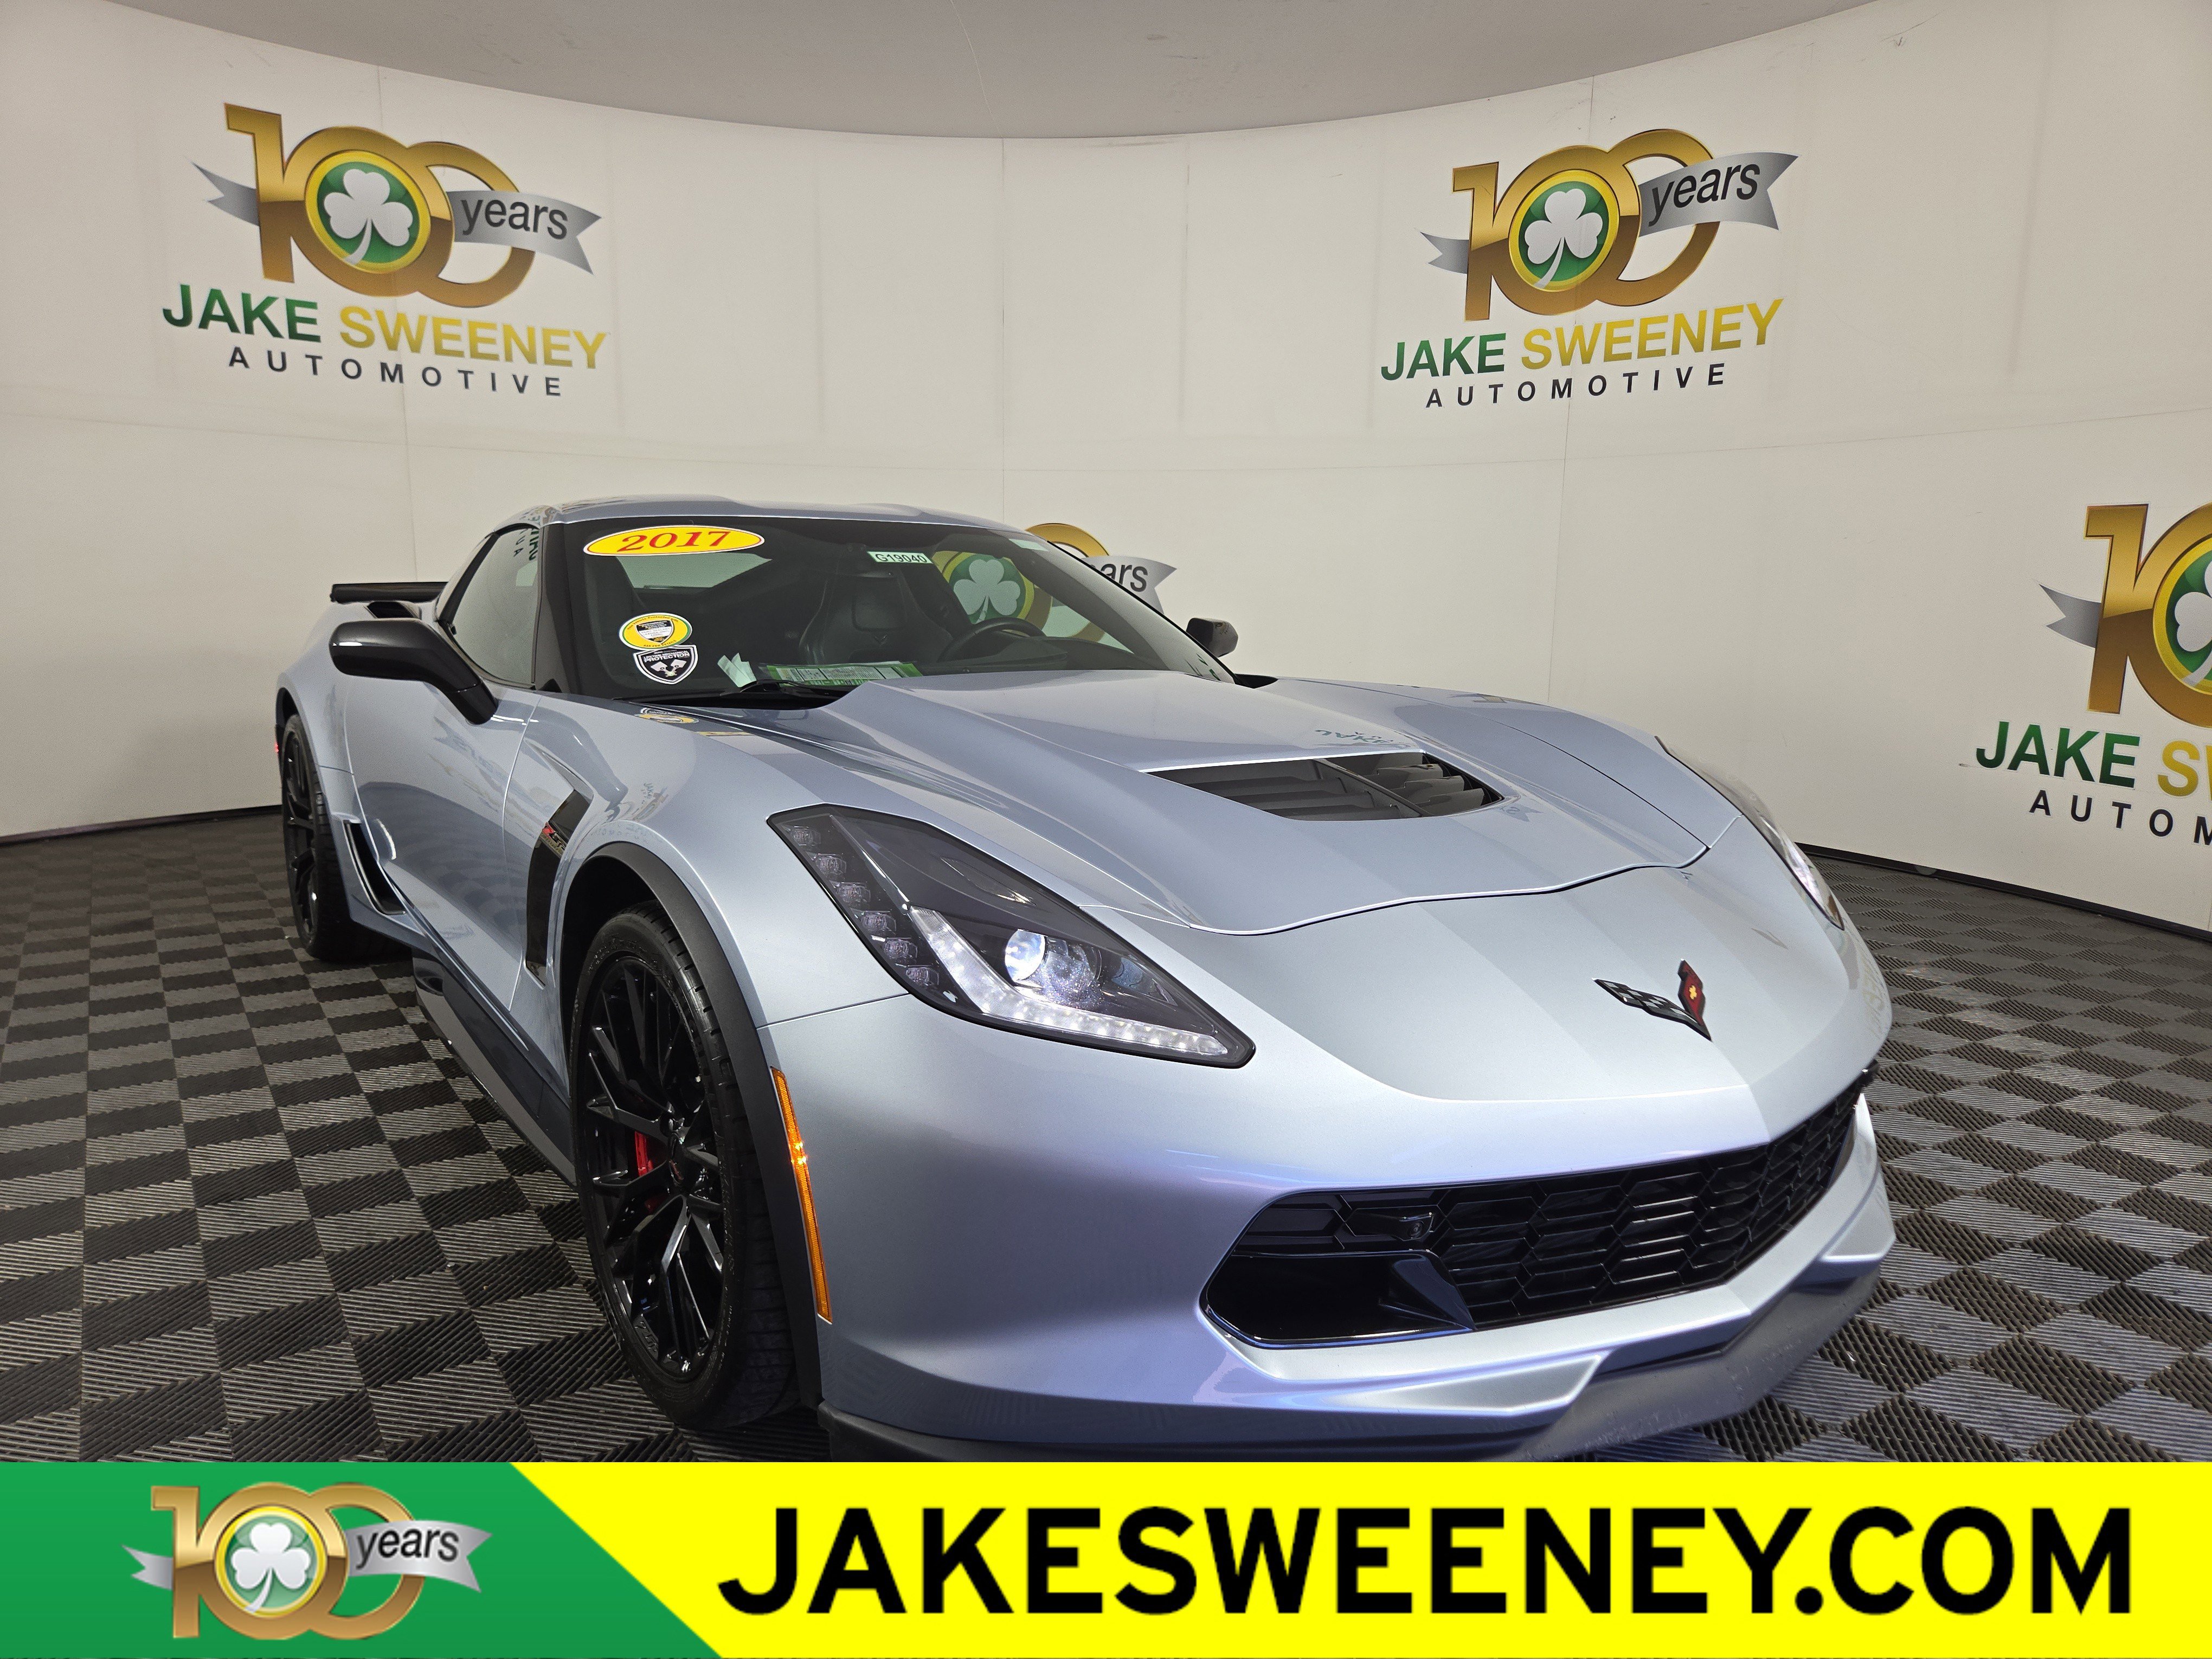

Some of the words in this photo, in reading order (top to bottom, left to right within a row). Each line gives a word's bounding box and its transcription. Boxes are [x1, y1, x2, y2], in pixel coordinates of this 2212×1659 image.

[223, 102, 536, 308] 100
[460, 199, 568, 240] years
[1452, 128, 1721, 321] 100
[1648, 164, 1760, 227] years
[162, 284, 321, 343] JAKE
[339, 305, 606, 369] SWEENEY
[1381, 332, 1507, 381] JAKE
[1521, 298, 1784, 370] SWEENEY
[229, 346, 561, 396] AUTOMOTIVE
[1426, 363, 1725, 408] AUTOMOTIVE
[617, 531, 731, 552] 2017
[875, 554, 928, 563] G19040
[1090, 563, 1148, 592] ars
[644, 652, 690, 663] PROTECTION
[1976, 721, 2141, 789] JAKE
